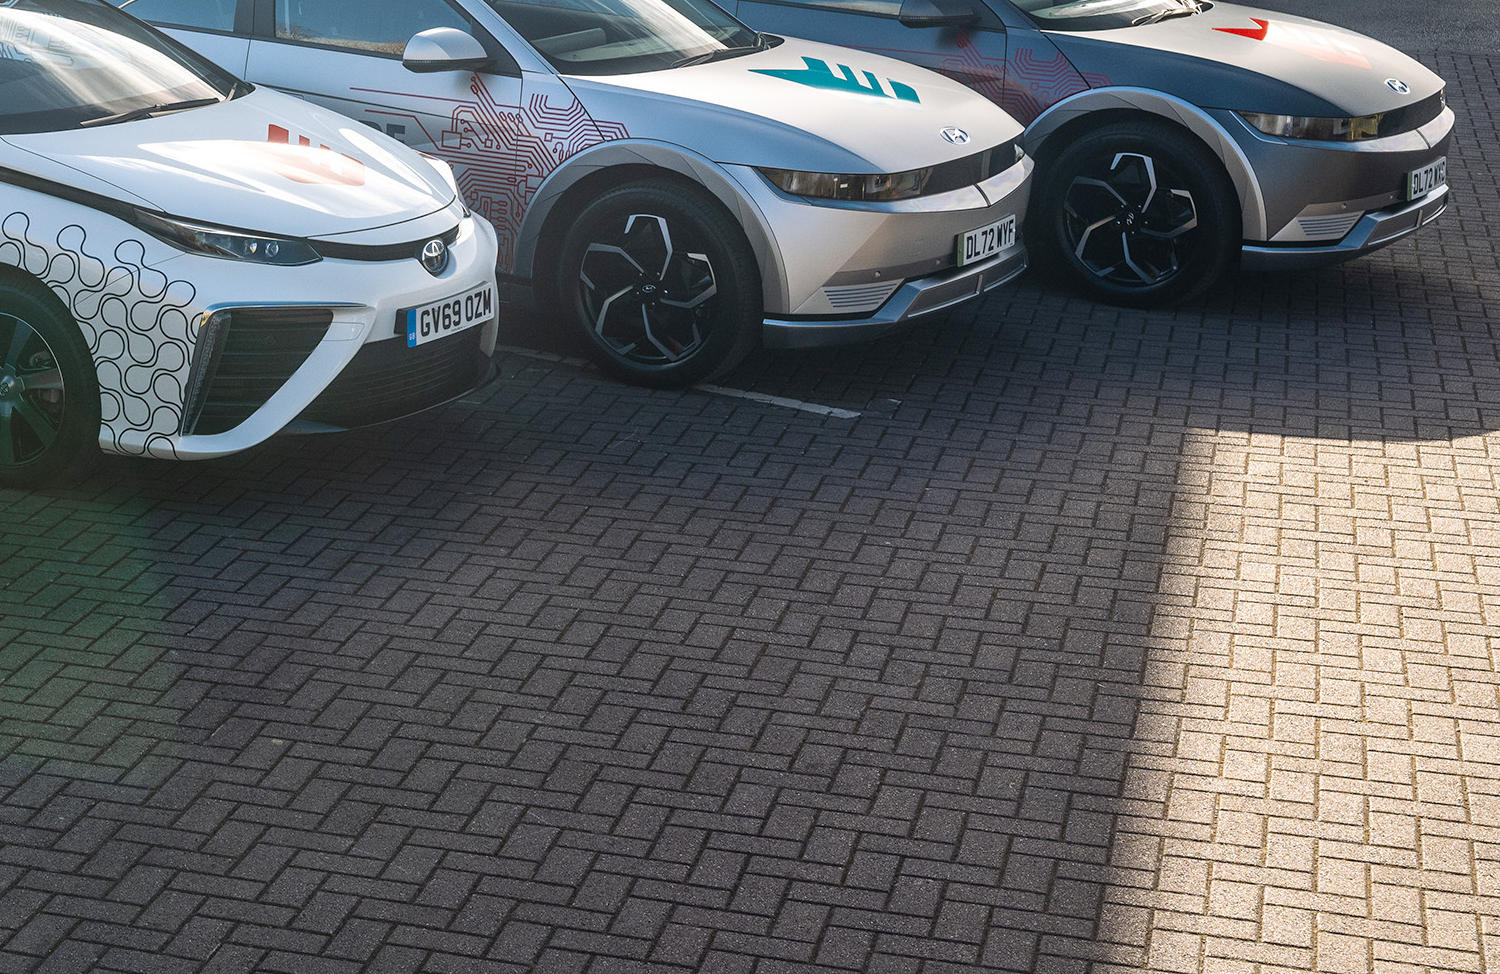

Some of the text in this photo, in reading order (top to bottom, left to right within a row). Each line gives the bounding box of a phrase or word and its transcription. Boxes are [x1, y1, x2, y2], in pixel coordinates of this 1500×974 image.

[1413, 168, 1434, 195] DL72
[966, 227, 994, 260] DL72
[420, 287, 491, 337] GV69 OZM
